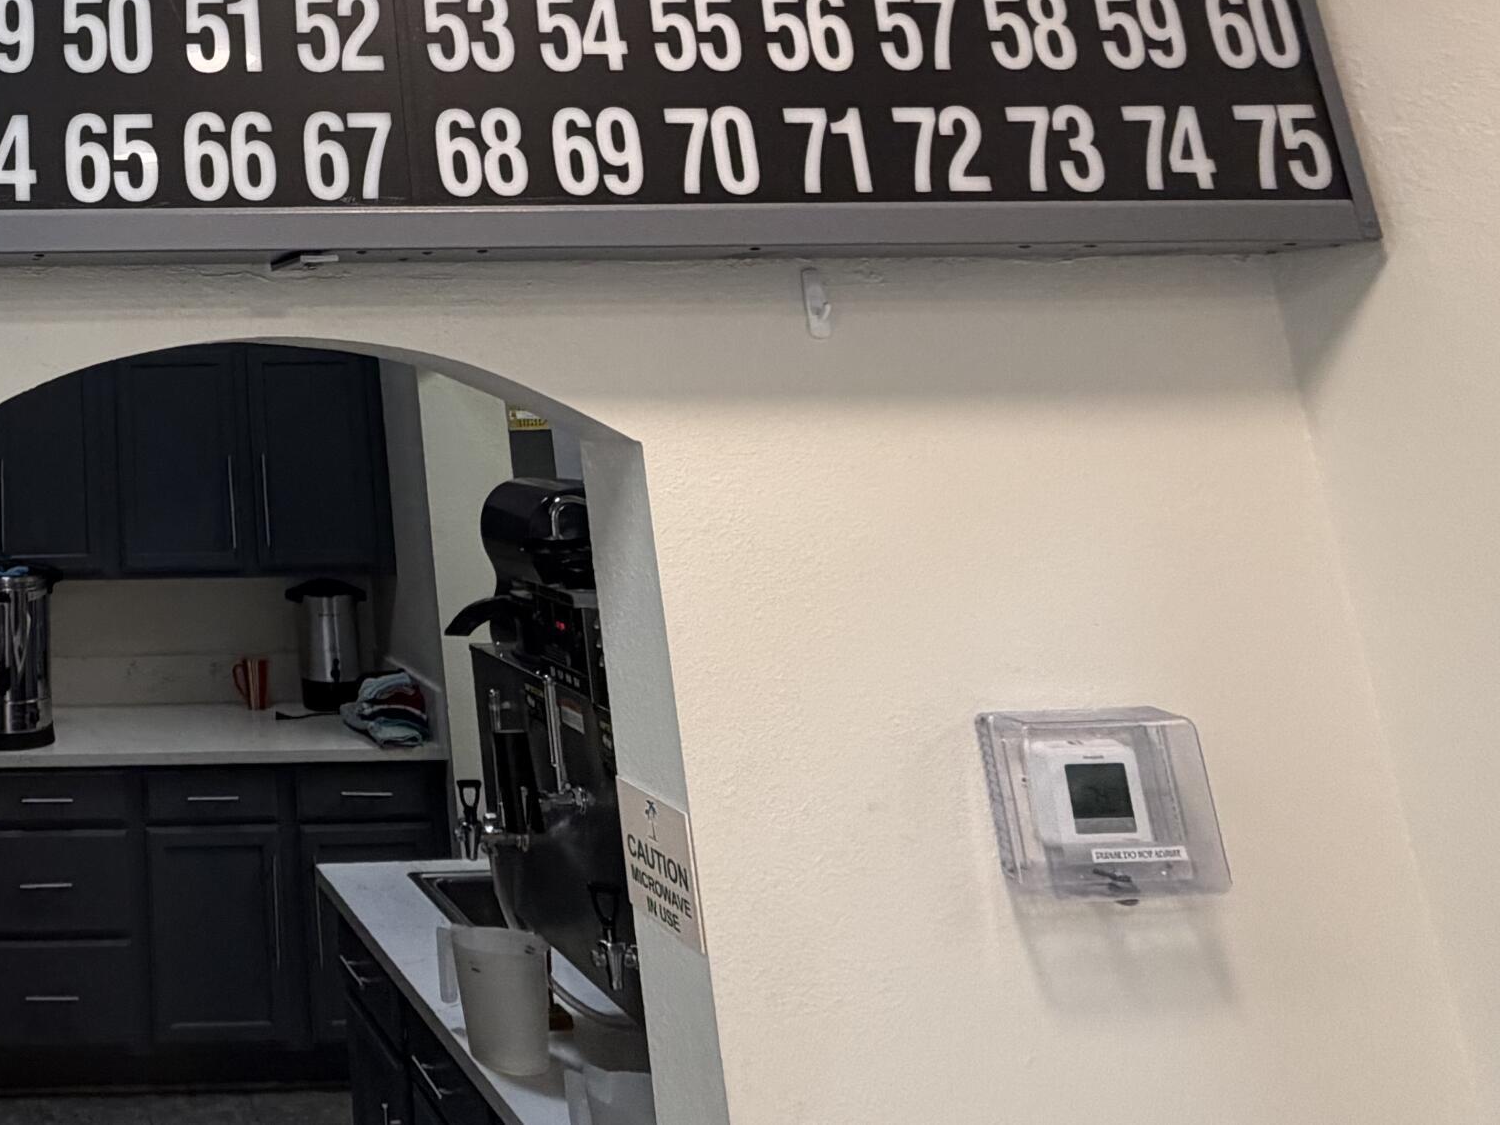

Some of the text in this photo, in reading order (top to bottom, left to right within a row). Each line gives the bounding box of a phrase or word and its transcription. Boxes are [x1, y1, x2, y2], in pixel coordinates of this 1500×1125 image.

[64, 112, 159, 204] 65
[183, 110, 277, 202] 66
[303, 110, 392, 201] 67
[435, 107, 529, 198] 68
[551, 106, 644, 196] 69
[663, 105, 760, 196] 70
[782, 107, 873, 194] 71
[891, 105, 992, 193] 72
[1004, 104, 1105, 193] 73
[1121, 105, 1217, 190] 74
[1232, 104, 1332, 190] 75
[627, 834, 690, 892] CAUTION
[630, 863, 693, 919] MICROWAVE
[646, 895, 682, 933] IN USE
